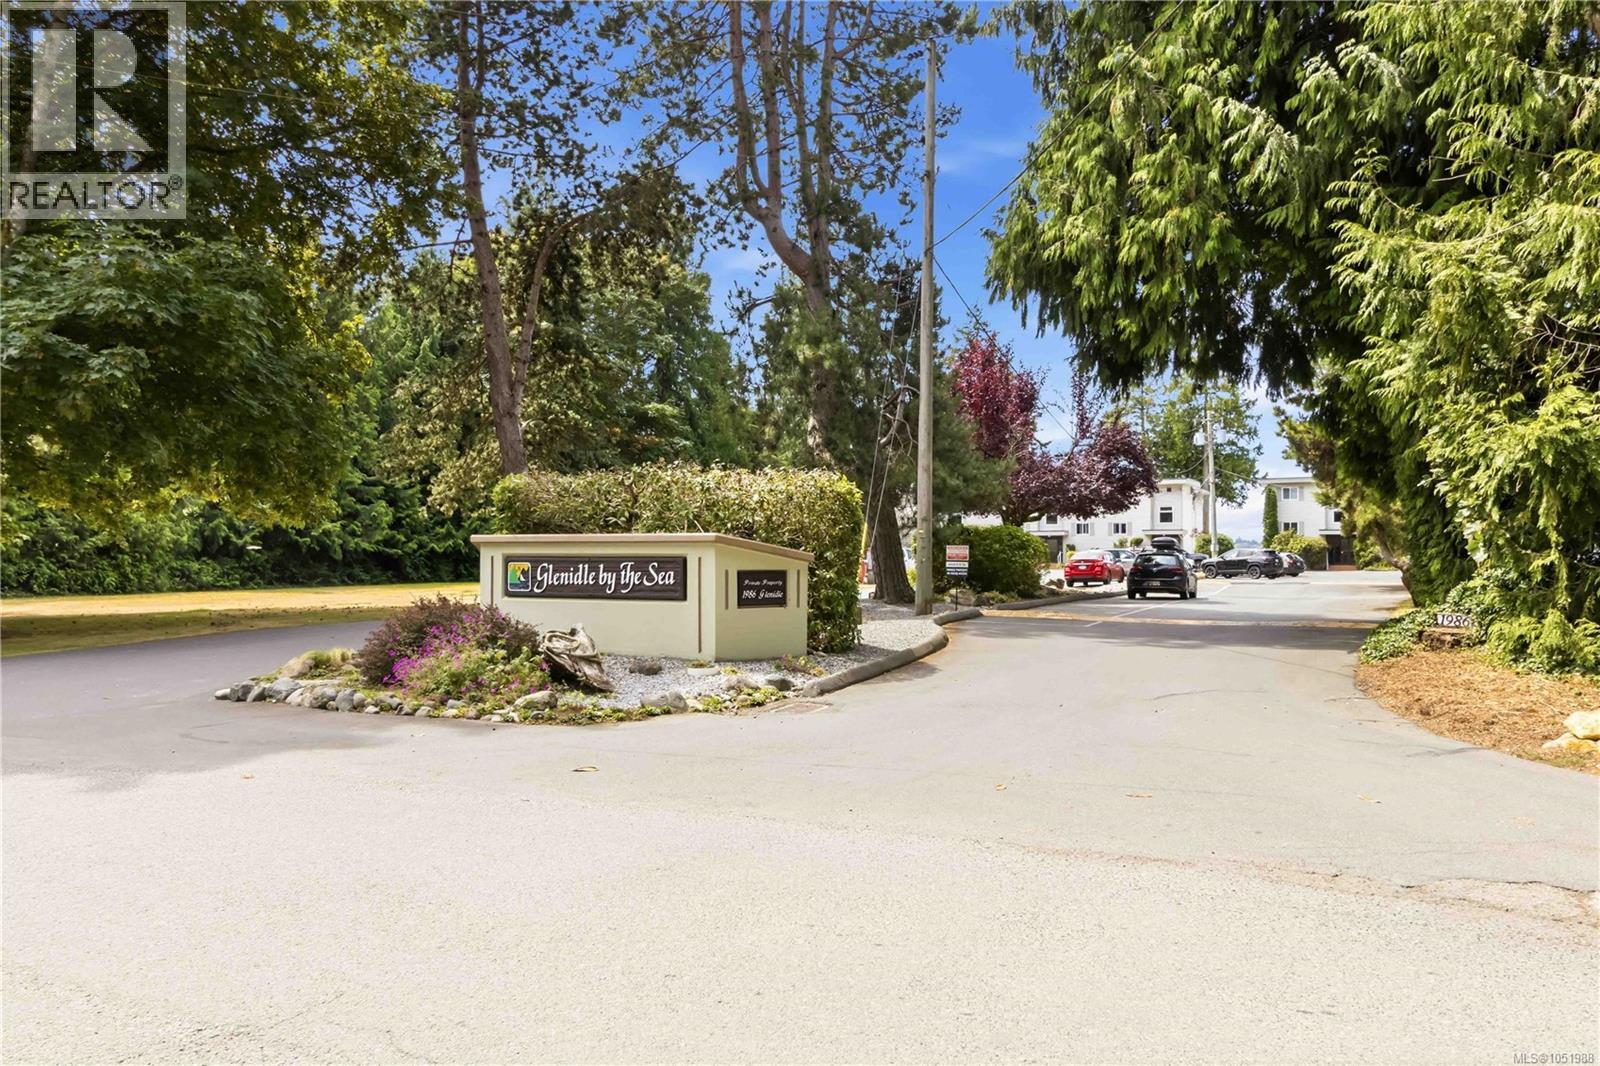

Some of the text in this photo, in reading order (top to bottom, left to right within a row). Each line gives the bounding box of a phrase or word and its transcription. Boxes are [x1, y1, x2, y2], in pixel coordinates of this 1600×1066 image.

[534, 562, 675, 594] Glenidle by The Sea
[742, 590, 757, 599] 1986
[1441, 614, 1470, 627] 1986
